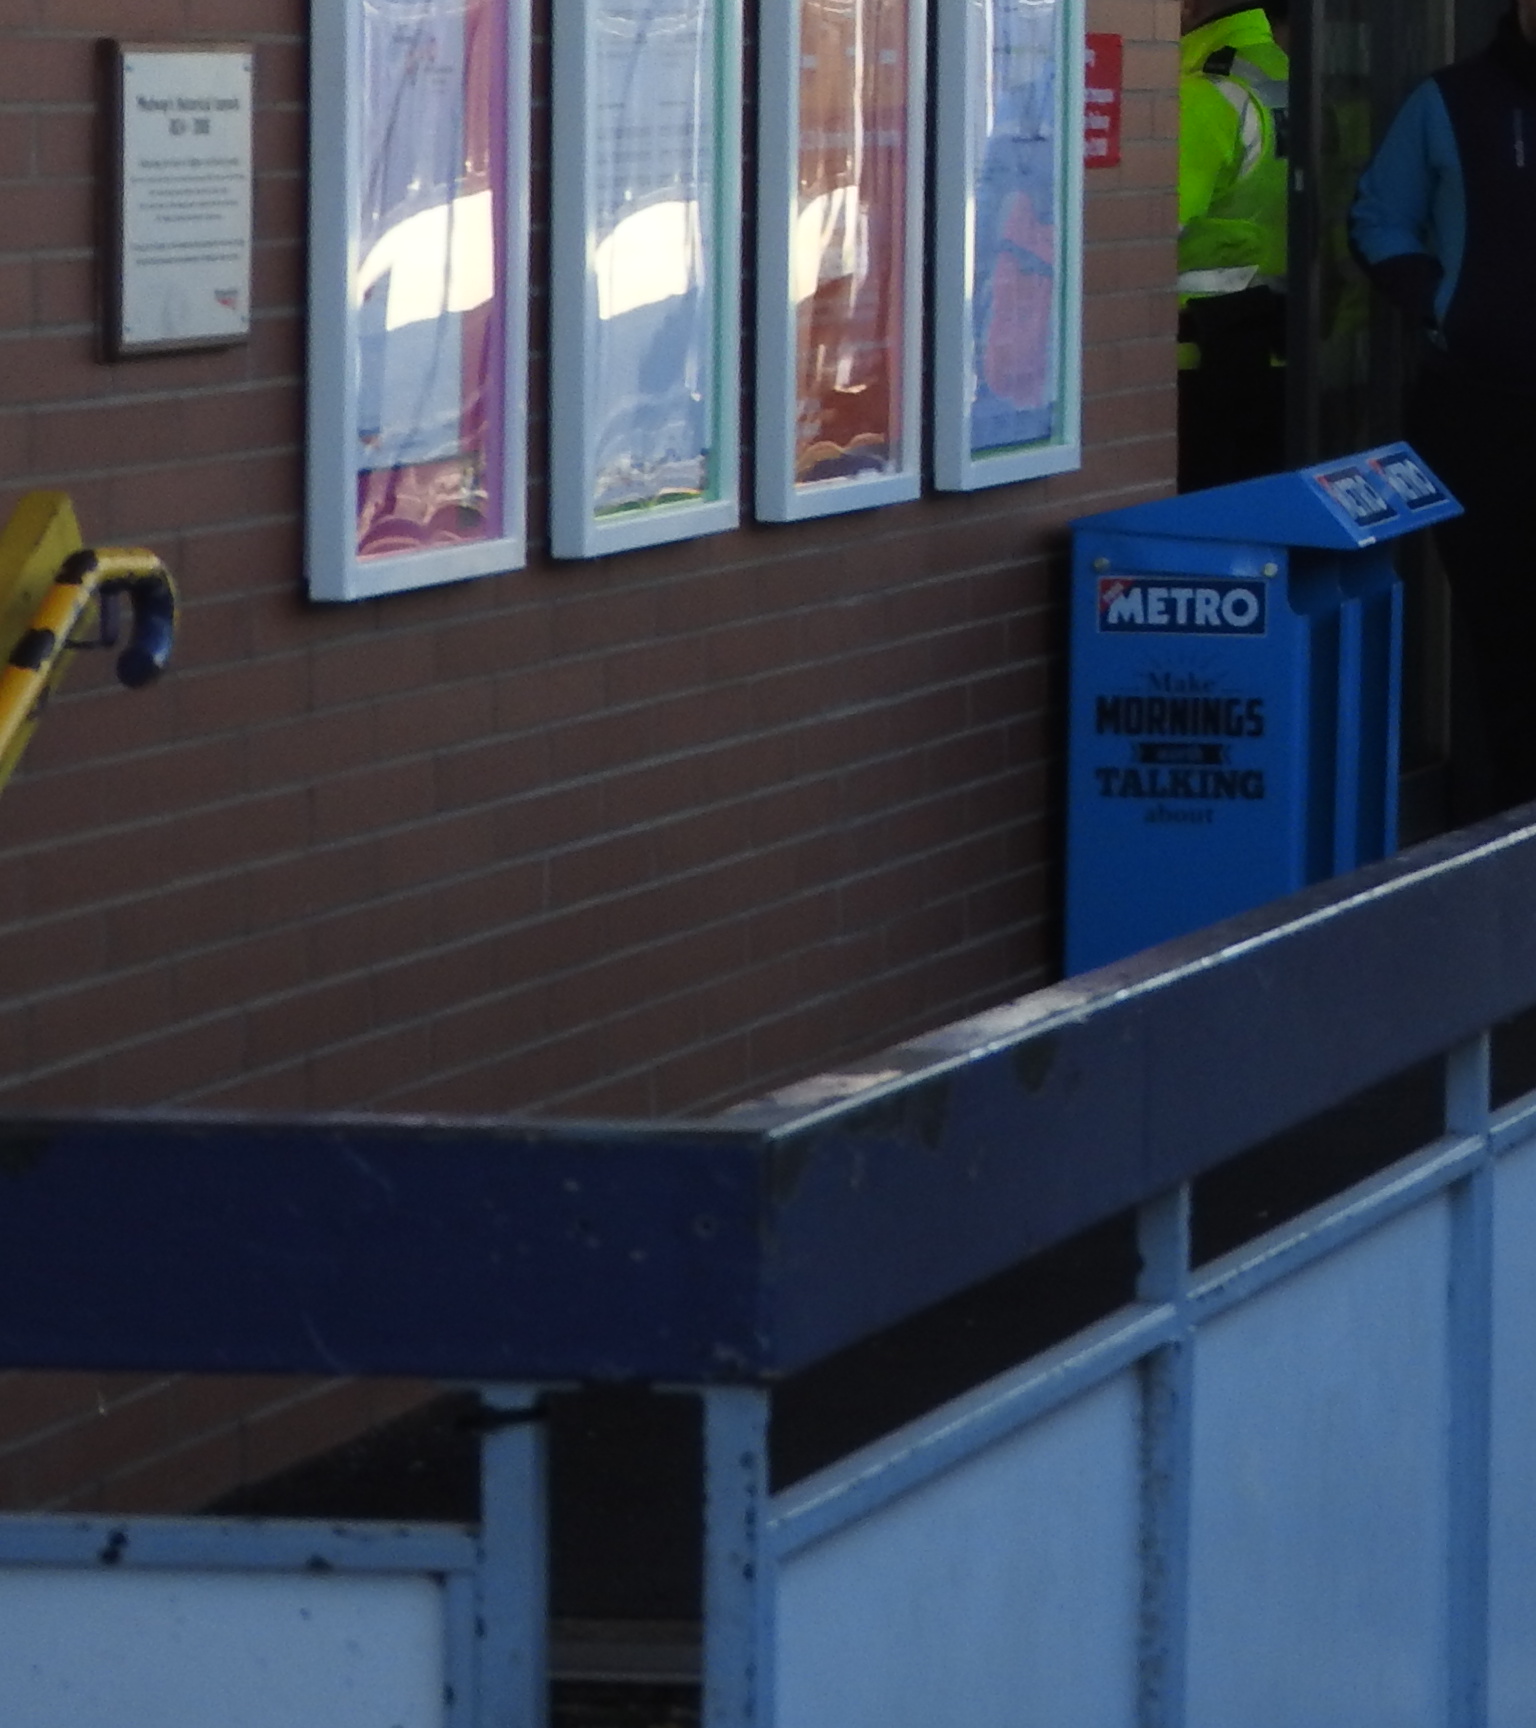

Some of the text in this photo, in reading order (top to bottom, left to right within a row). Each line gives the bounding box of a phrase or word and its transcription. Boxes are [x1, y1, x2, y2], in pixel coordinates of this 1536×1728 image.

[1106, 586, 1260, 628] METRO
[1096, 696, 1265, 737] MORNINGS
[1095, 767, 1265, 800] TALKING
